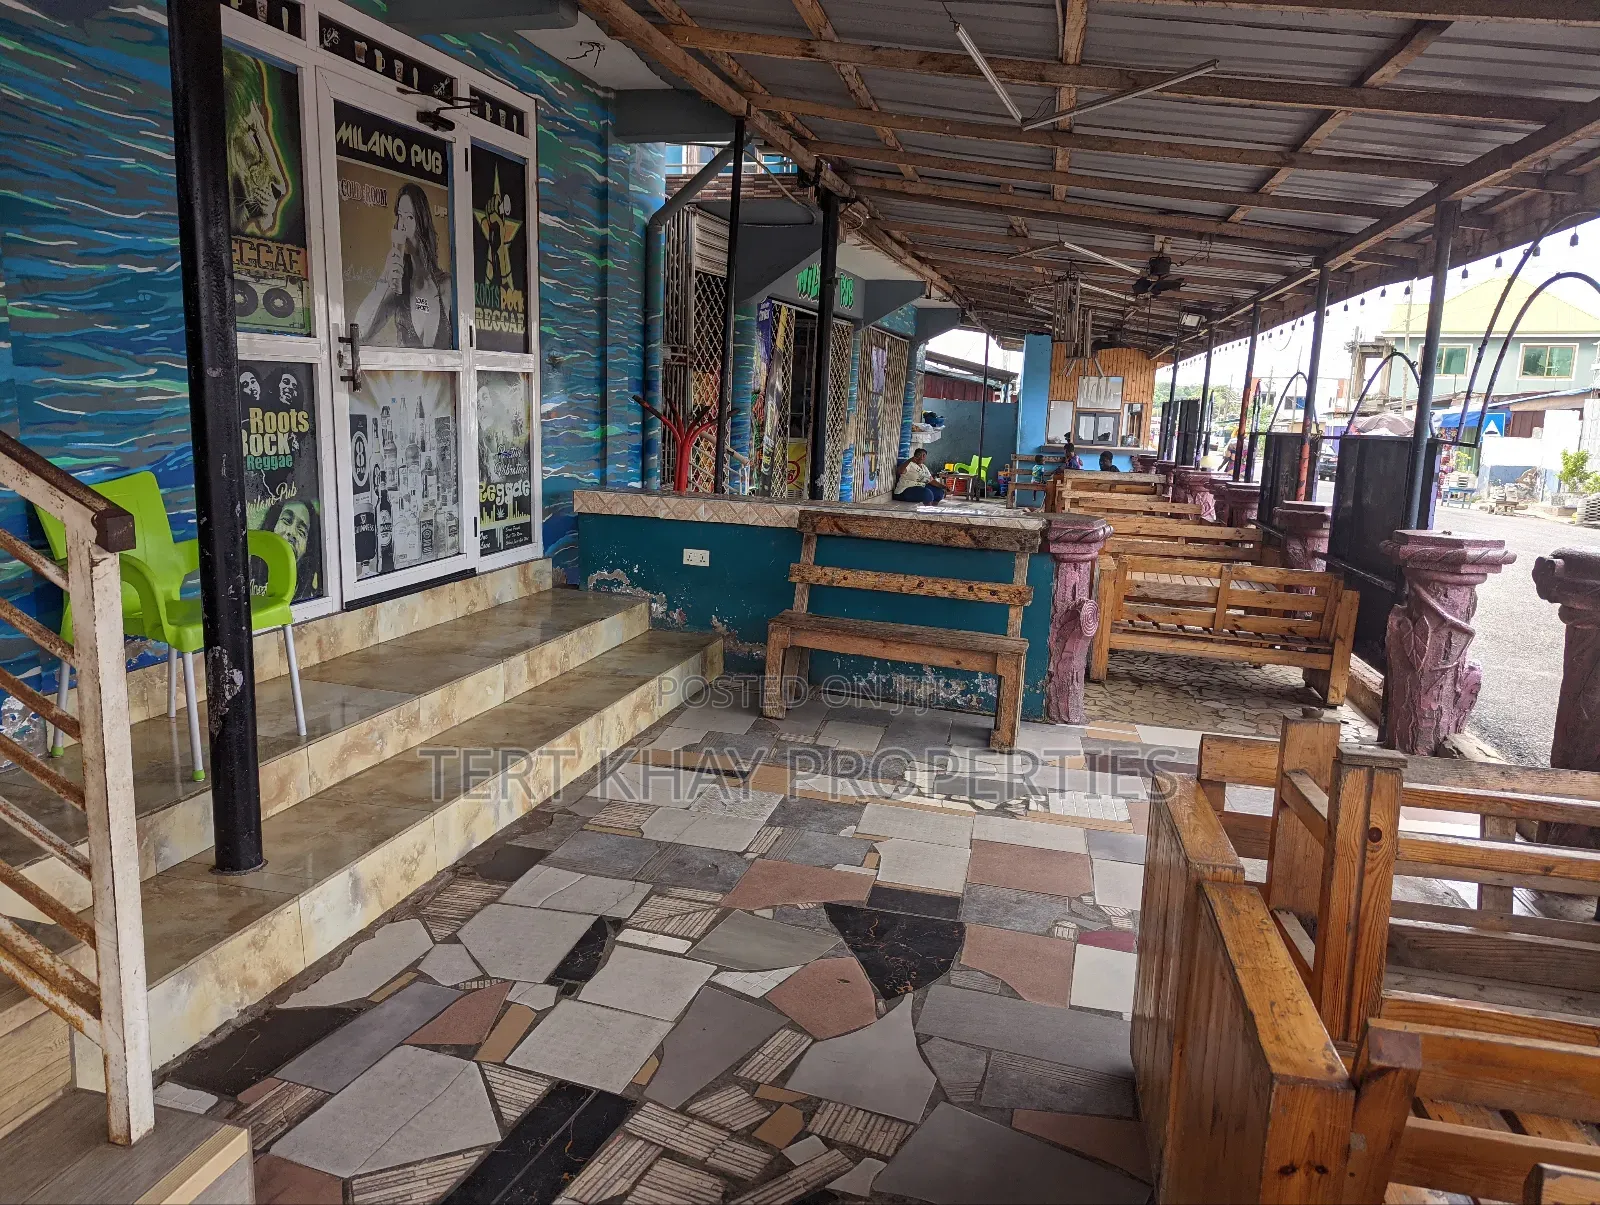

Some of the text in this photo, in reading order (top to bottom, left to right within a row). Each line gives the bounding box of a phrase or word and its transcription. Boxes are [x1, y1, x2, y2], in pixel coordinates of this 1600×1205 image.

[336, 121, 443, 175] MILANO PUB
[231, 238, 302, 275] EGGAE
[475, 307, 525, 334] REGGAE
[248, 407, 310, 434] Roots
[246, 455, 293, 471] Reggae
[275, 481, 298, 502] Pub
